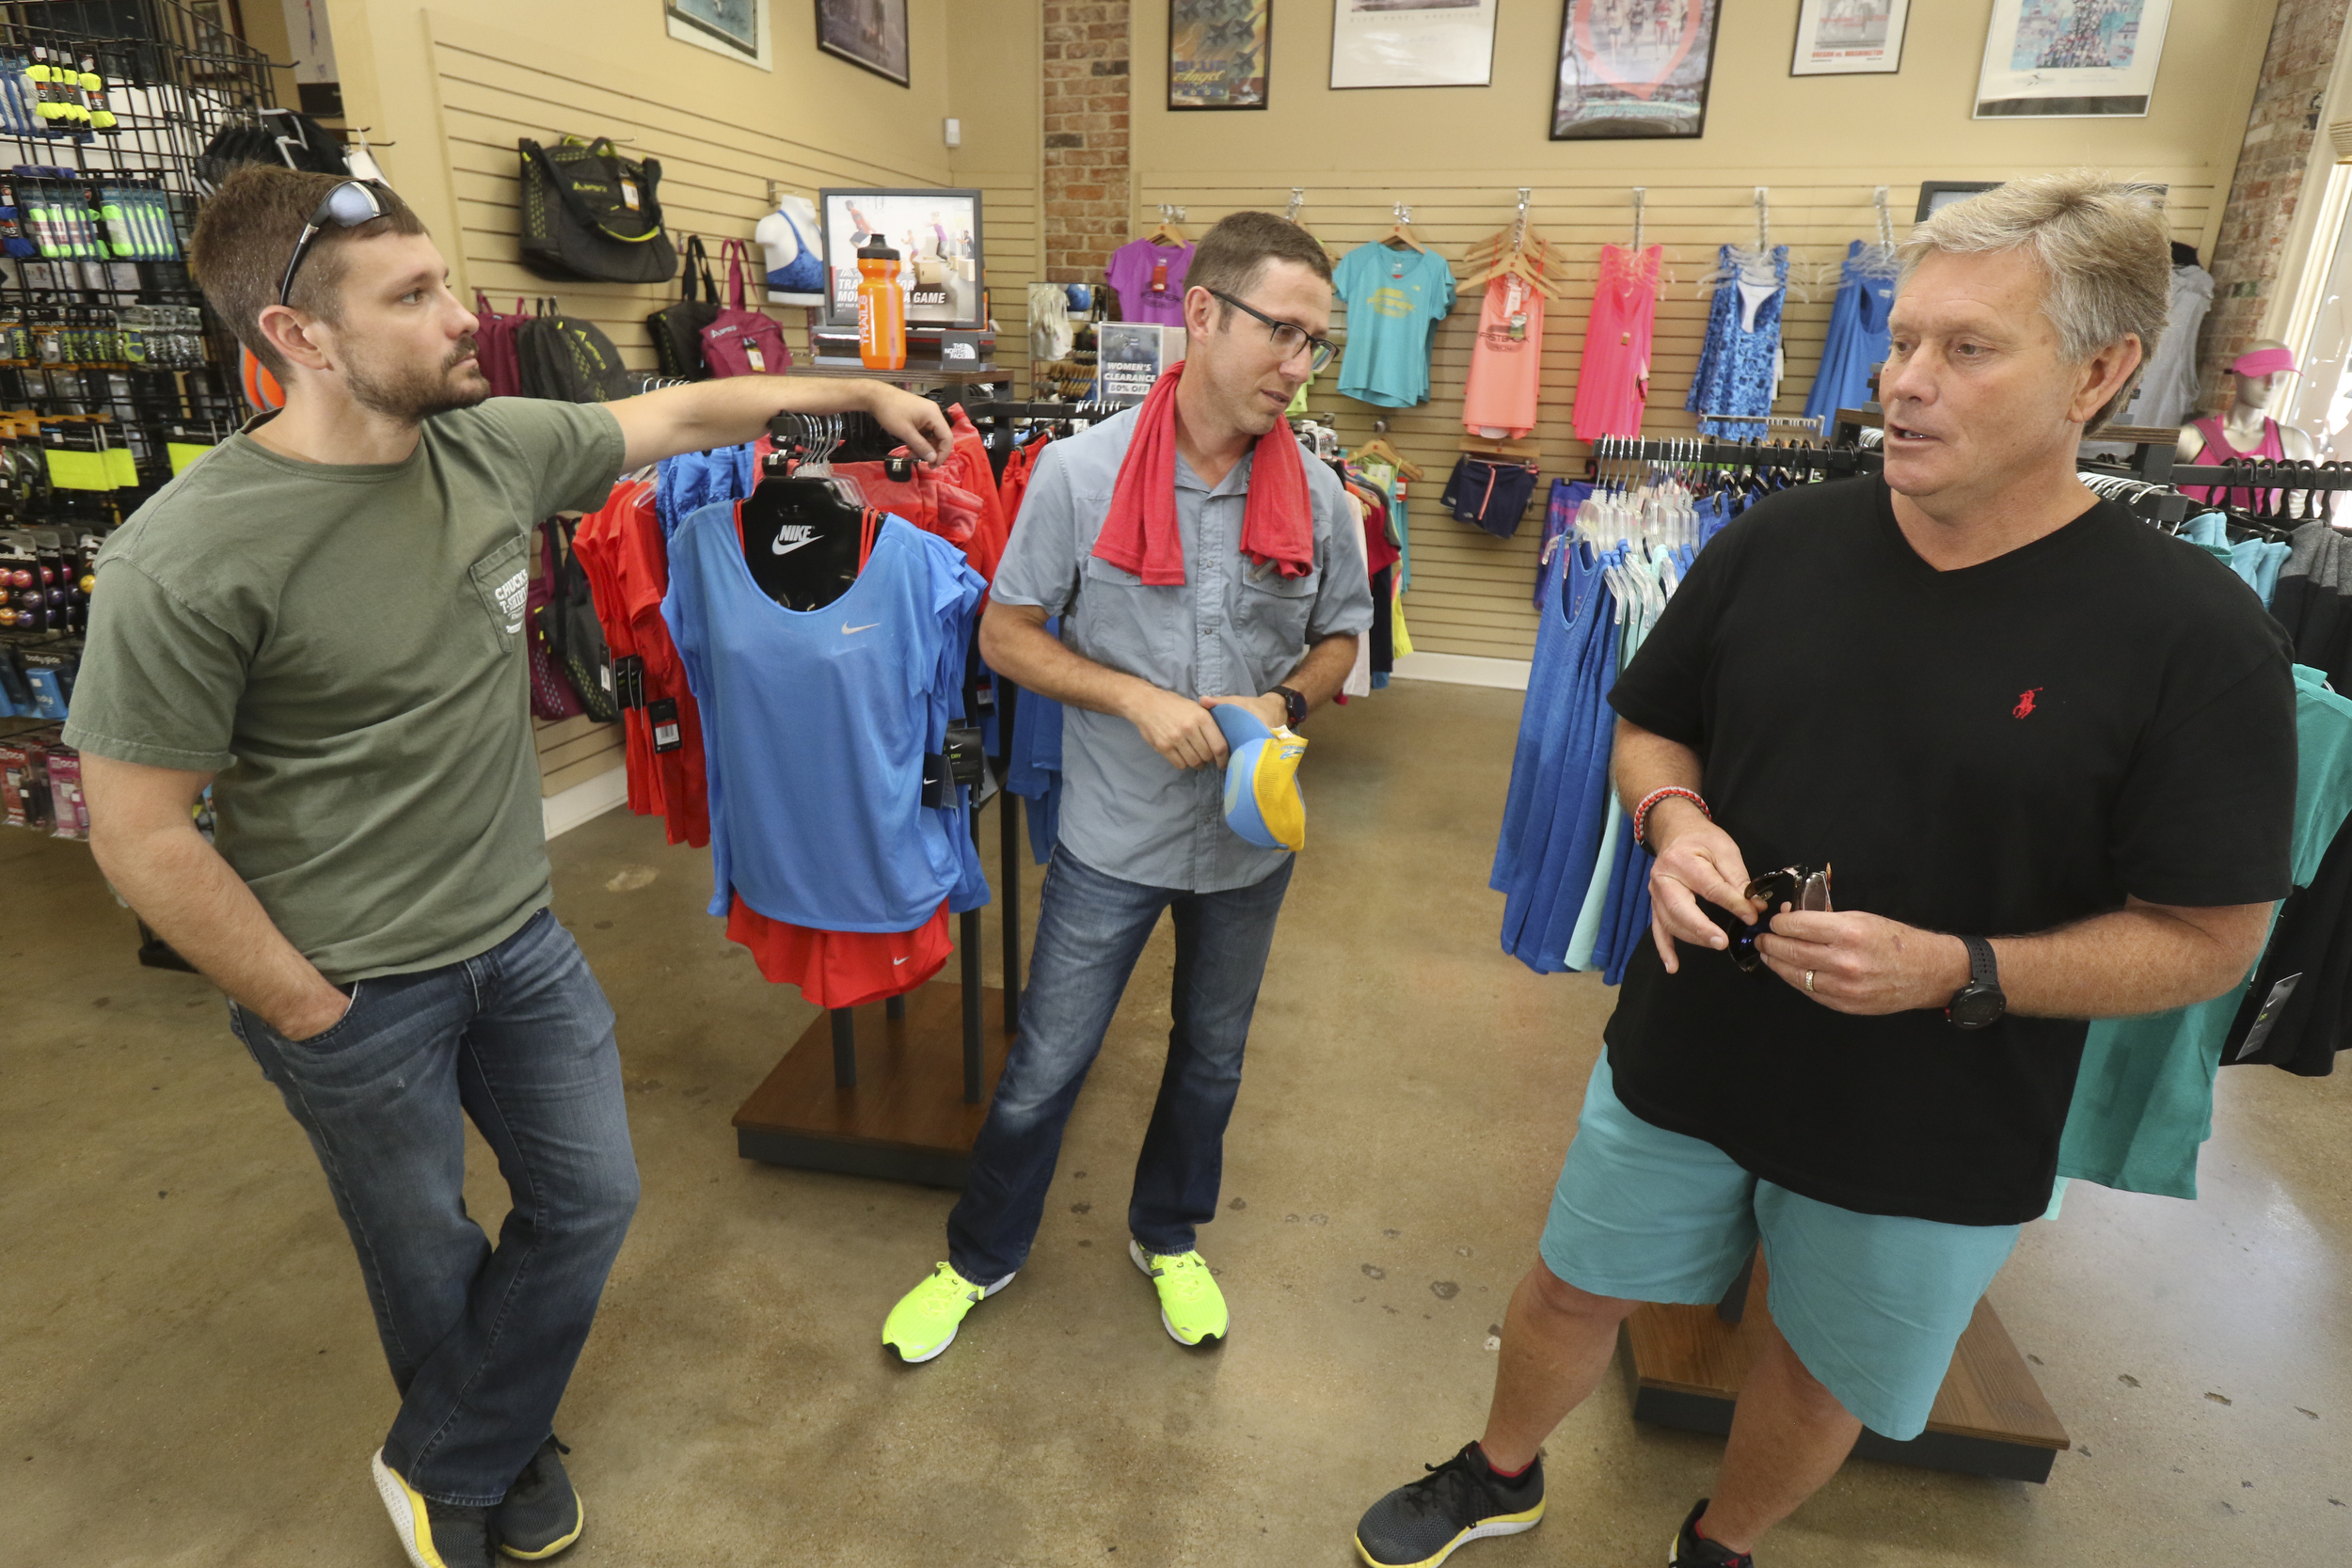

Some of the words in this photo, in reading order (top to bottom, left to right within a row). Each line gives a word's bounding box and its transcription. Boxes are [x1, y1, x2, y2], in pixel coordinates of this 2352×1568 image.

[838, 278, 858, 290] TRA
[837, 291, 858, 302] MO
[913, 292, 946, 304] GAME
[1107, 362, 1152, 372] WOMEN'S
[1104, 372, 1156, 383] CLEARANCE
[1110, 383, 1130, 392] 50%
[1131, 384, 1149, 393] OFF
[779, 524, 812, 542] NIKE
